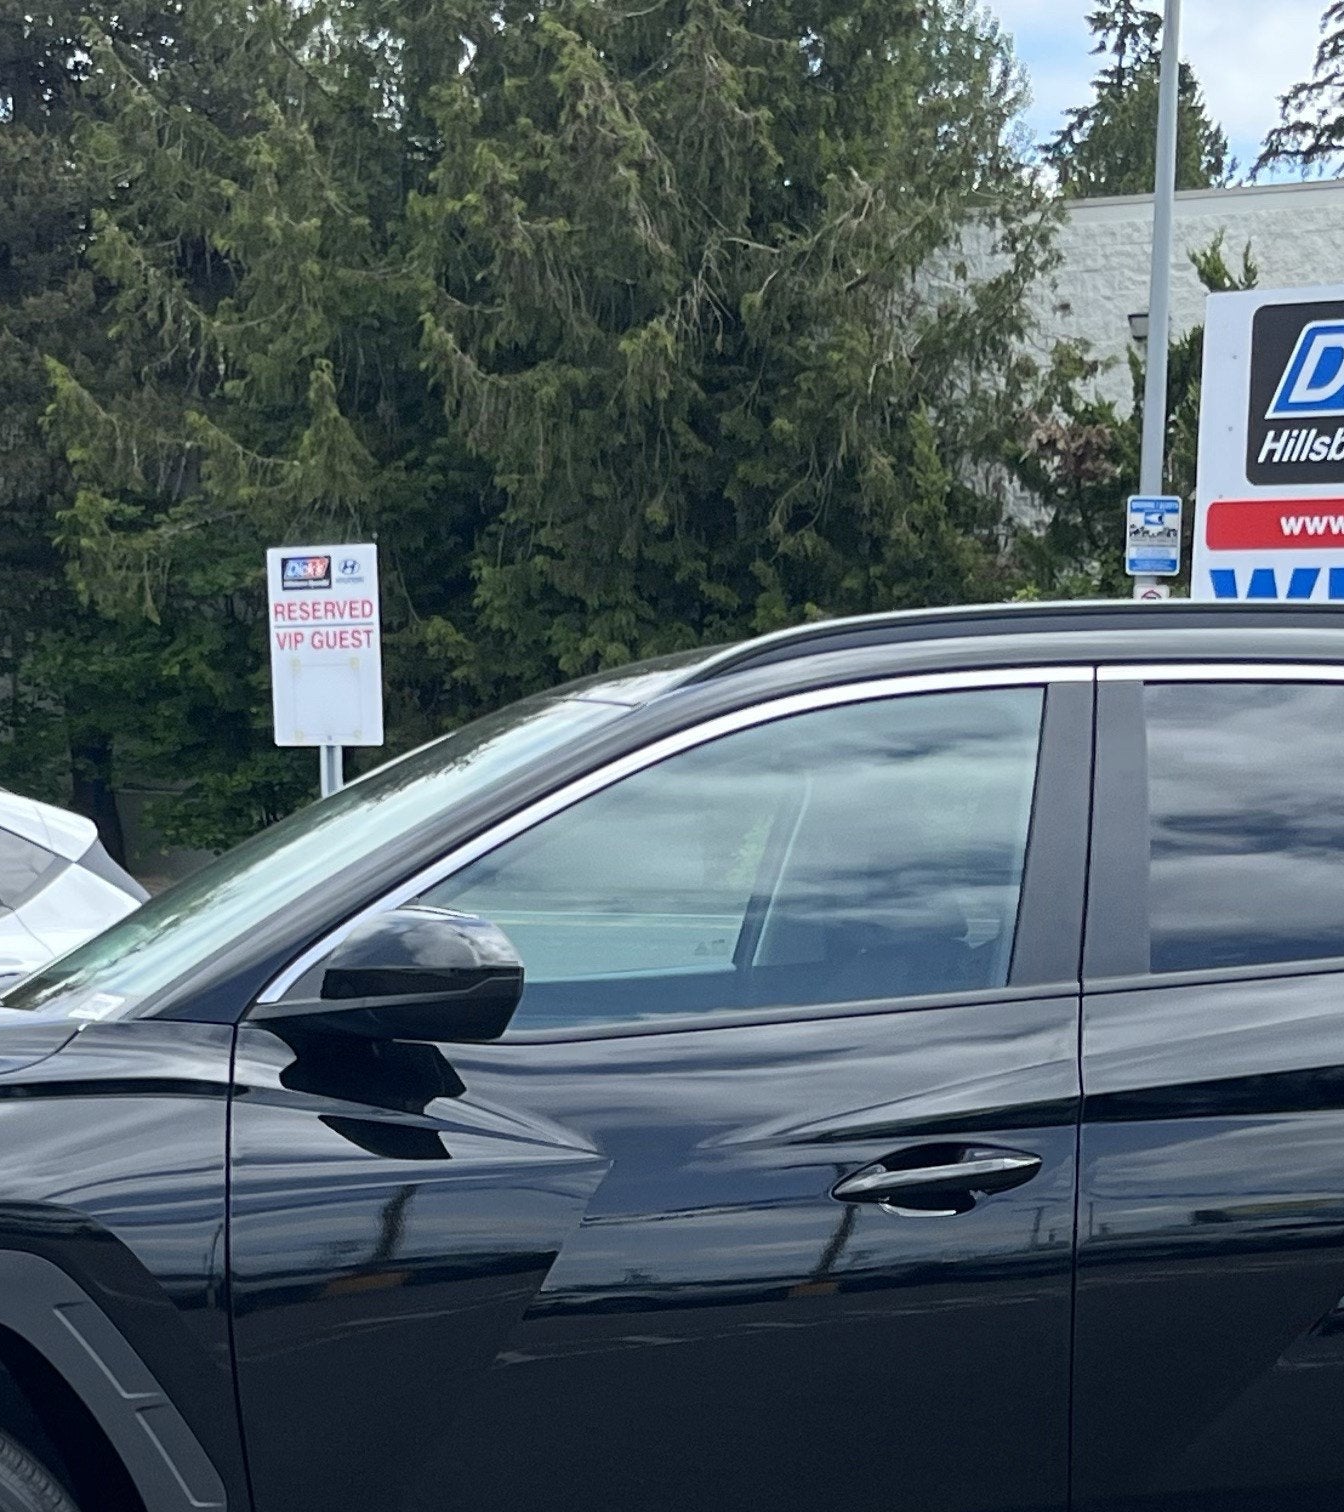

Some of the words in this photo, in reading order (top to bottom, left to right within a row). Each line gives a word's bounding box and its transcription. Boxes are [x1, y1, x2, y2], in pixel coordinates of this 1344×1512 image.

[274, 600, 373, 622] RESERVED
[276, 632, 304, 649] VIP
[311, 630, 373, 649] GUEST
